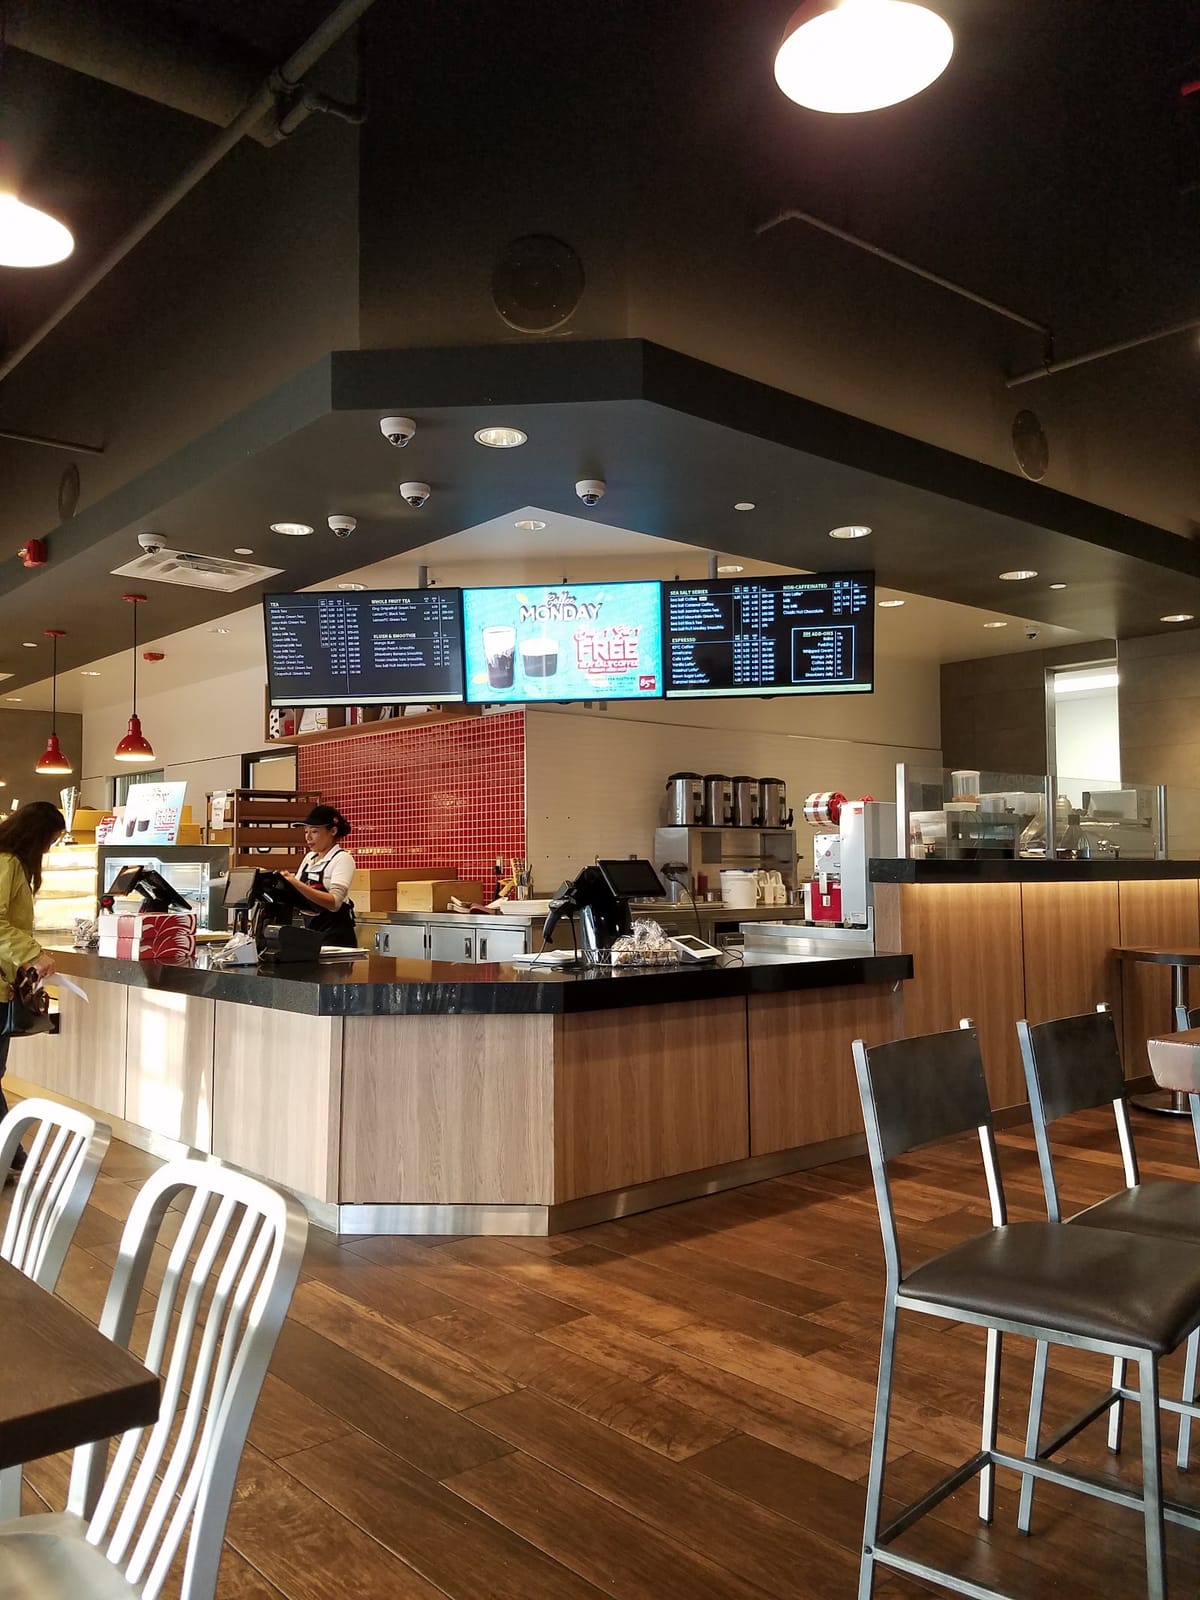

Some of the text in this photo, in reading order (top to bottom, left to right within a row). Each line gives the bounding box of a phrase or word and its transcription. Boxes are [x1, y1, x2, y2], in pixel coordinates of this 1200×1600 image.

[545, 591, 577, 608] Coffee
[519, 602, 603, 624] MONDAY
[576, 640, 638, 661] FREE
